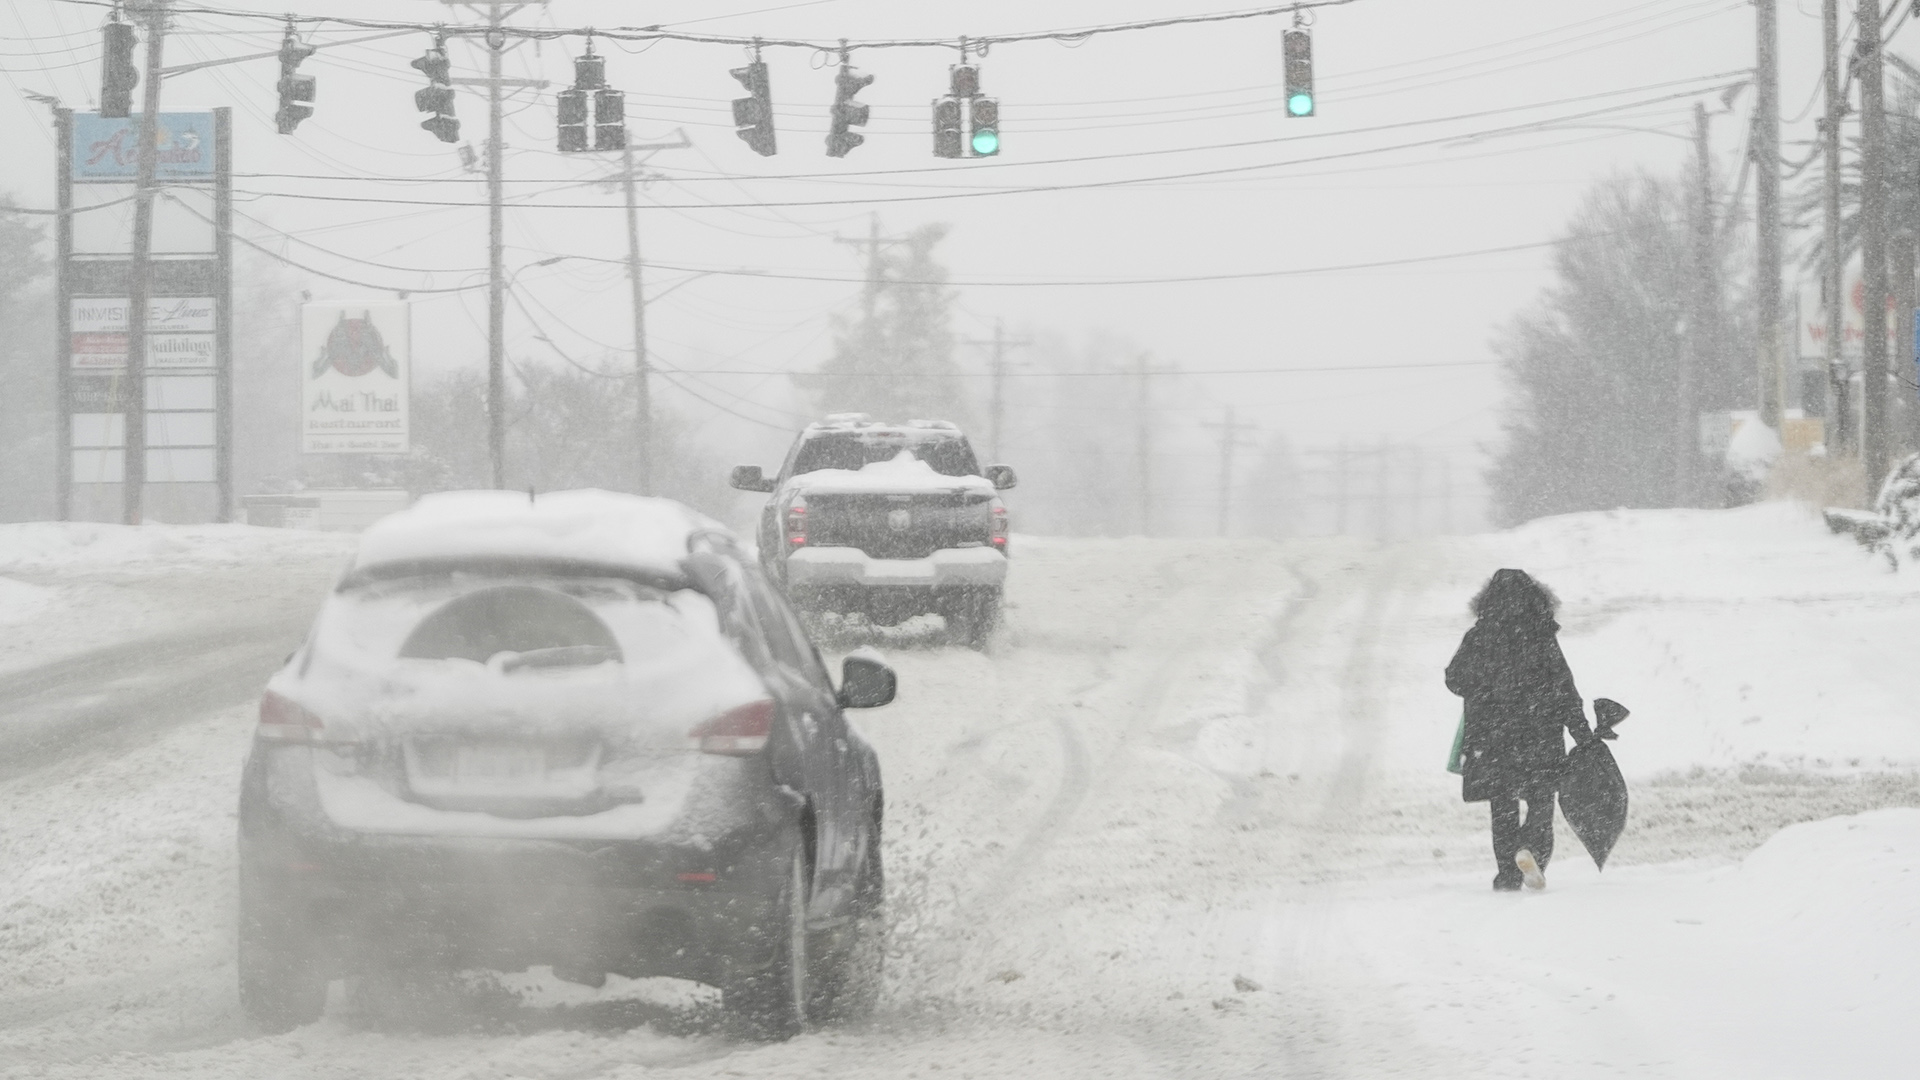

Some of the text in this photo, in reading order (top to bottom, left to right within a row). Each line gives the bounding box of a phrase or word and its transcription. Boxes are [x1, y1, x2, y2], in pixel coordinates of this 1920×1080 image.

[77, 306, 161, 321] INVISIE
[311, 389, 400, 412] Mai Thai
[309, 418, 403, 430] Restaurant
[280, 508, 313, 519] EASE
